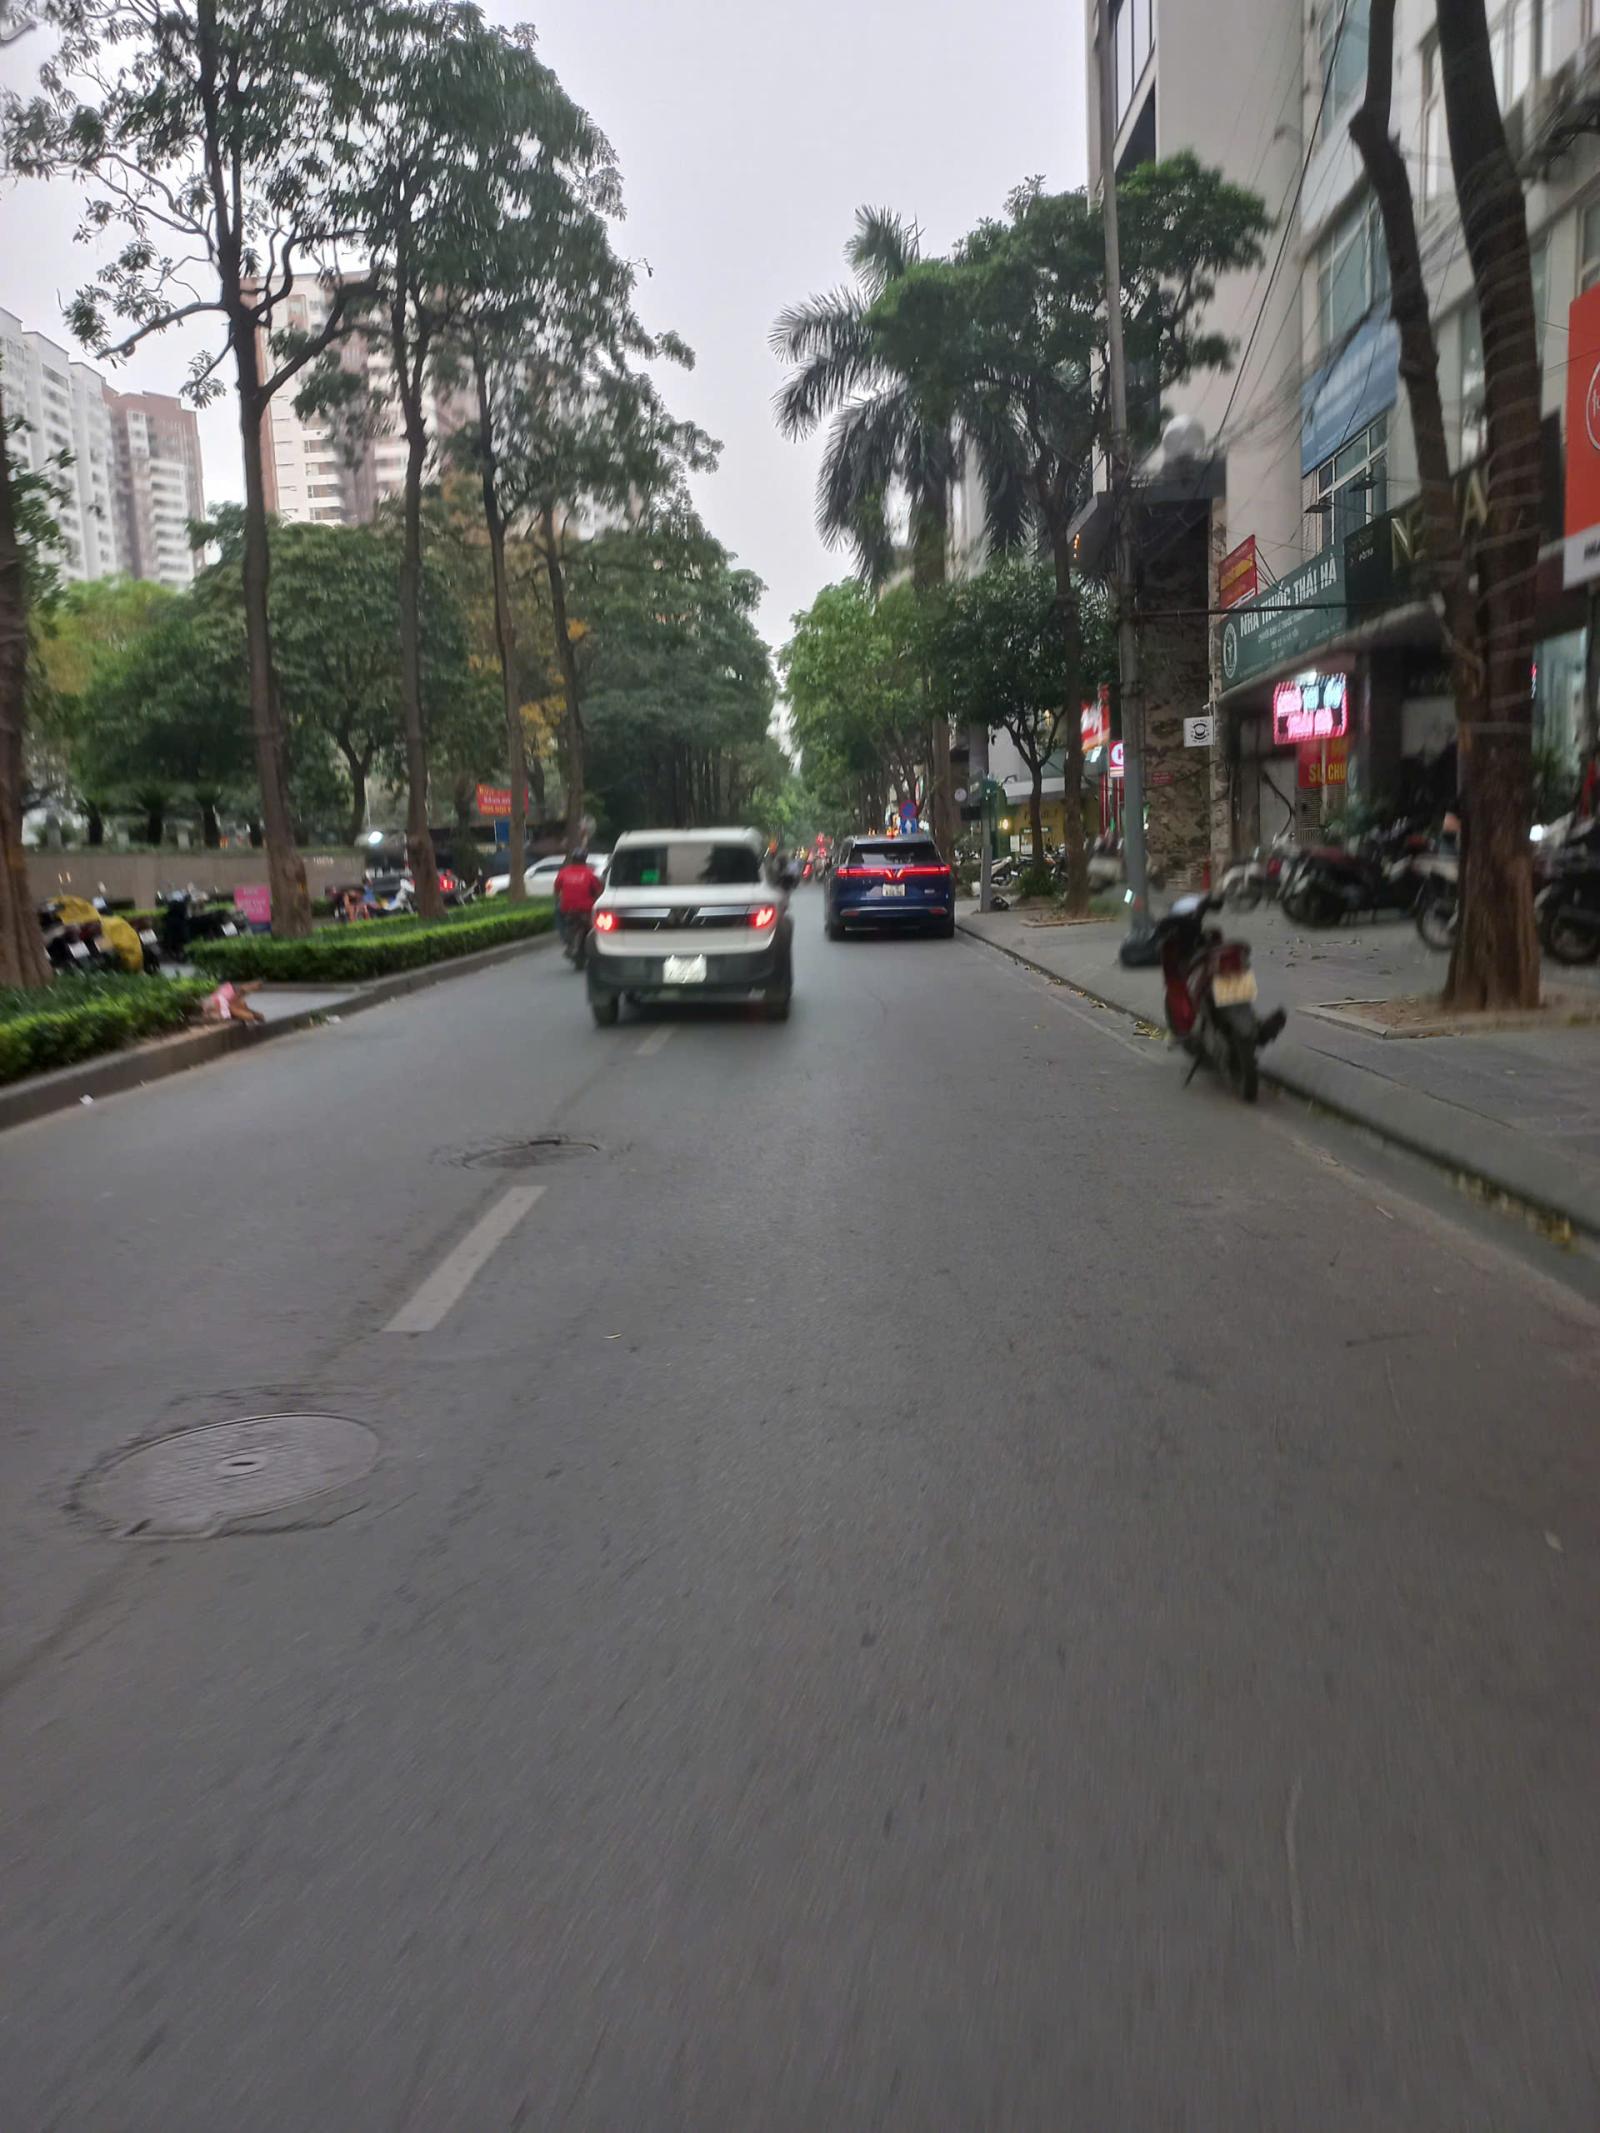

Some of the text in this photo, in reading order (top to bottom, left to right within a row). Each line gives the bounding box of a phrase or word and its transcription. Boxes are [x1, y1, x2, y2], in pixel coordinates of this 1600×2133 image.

[1240, 604, 1259, 638] NHÀ
[1260, 581, 1291, 625] THUỐC
[1293, 567, 1317, 605] THÁI
[1320, 553, 1337, 590] HÀ
